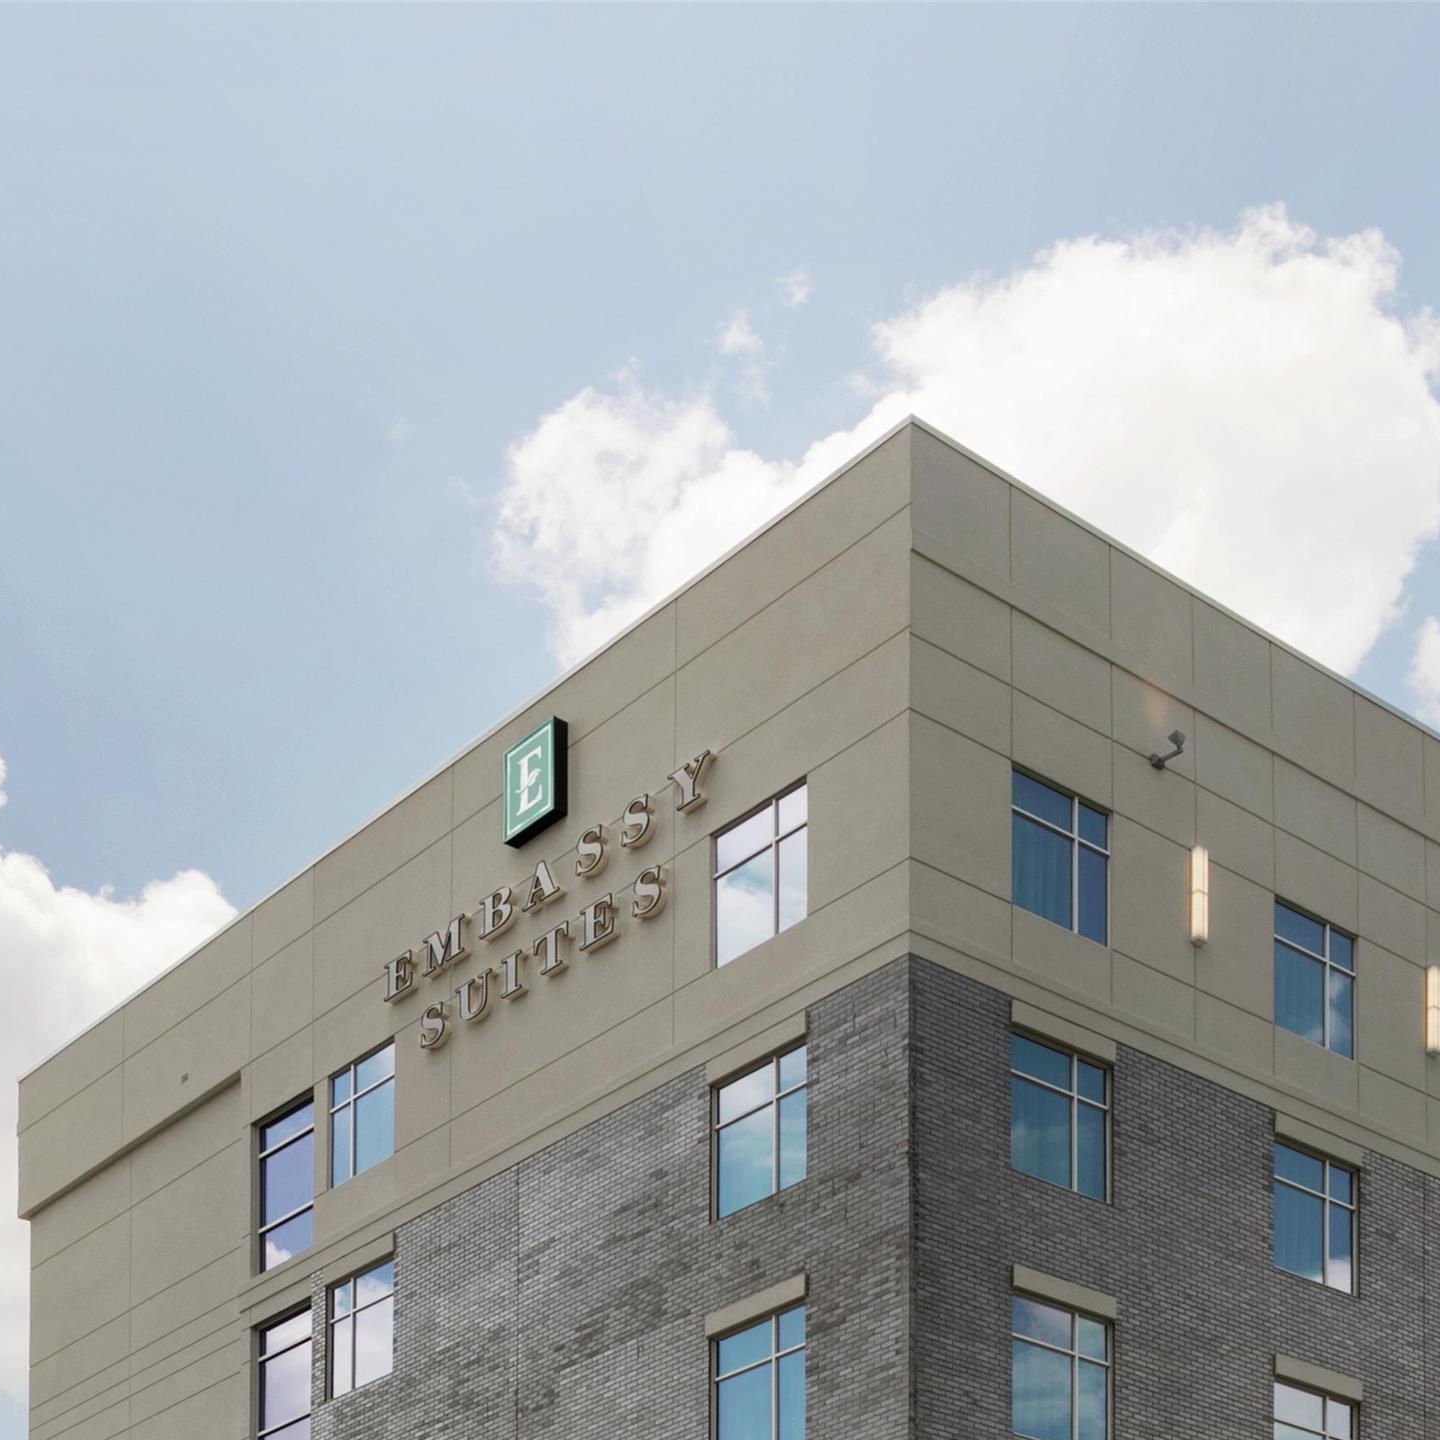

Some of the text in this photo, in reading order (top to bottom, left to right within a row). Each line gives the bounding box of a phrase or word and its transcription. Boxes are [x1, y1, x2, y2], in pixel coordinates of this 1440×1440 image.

[515, 748, 543, 817] E
[383, 749, 714, 1004] EMBASSY
[419, 864, 666, 1050] SUITES
